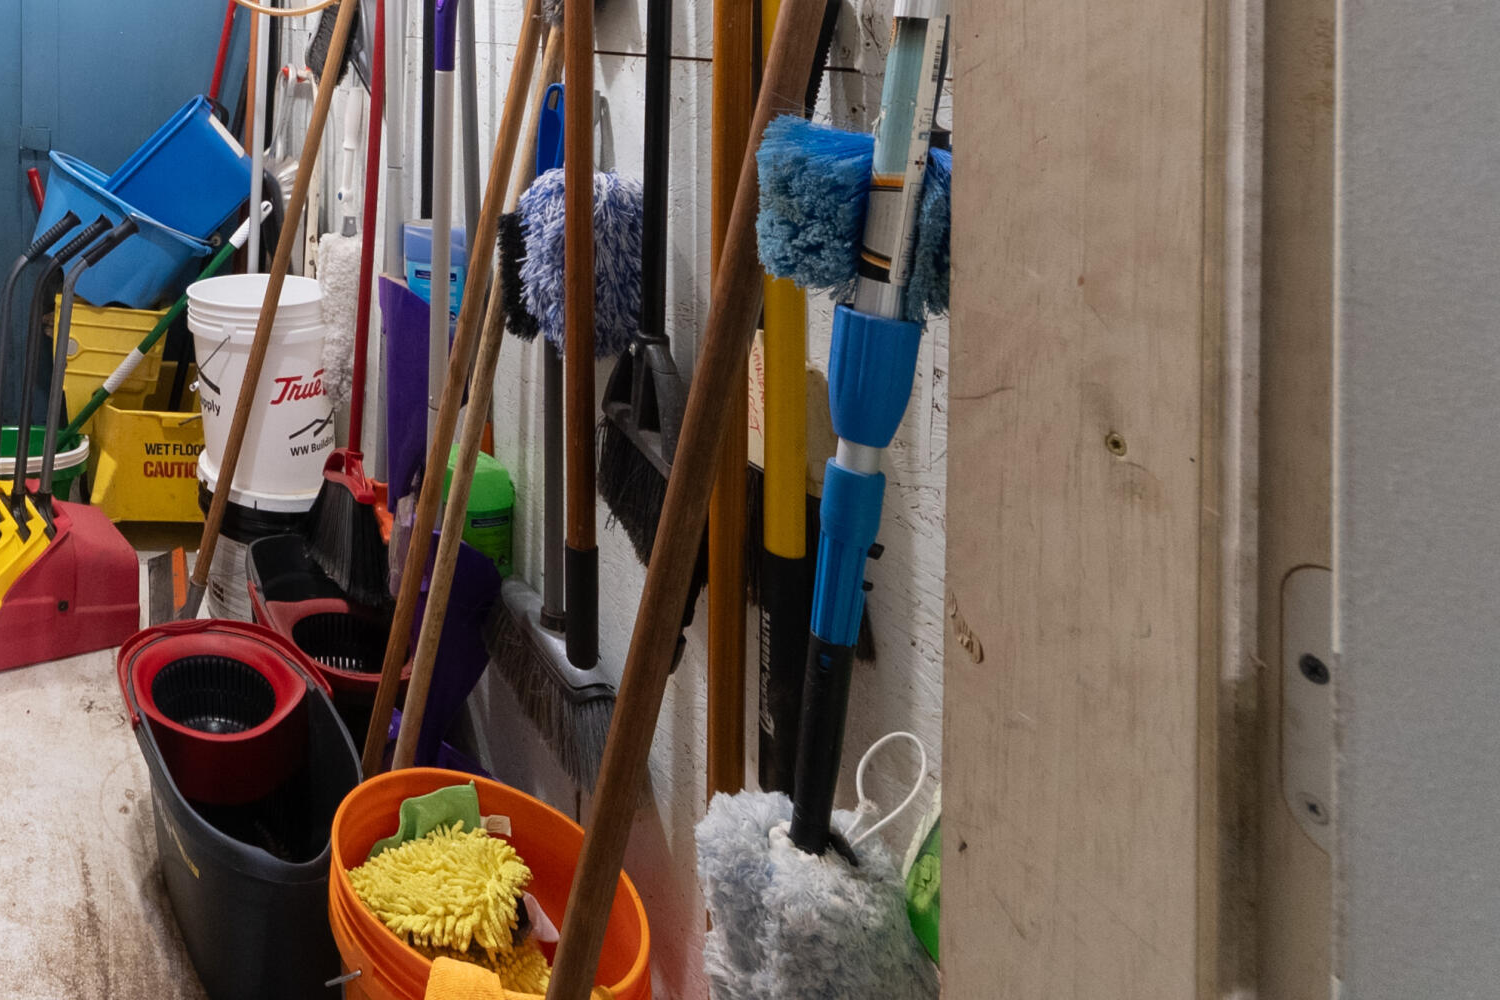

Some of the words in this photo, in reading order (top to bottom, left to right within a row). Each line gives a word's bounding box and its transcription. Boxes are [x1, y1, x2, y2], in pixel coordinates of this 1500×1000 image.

[144, 443, 173, 456] WET
[172, 443, 205, 456] FLOO
[289, 445, 310, 458] WW
[310, 436, 335, 453] Buildin
[143, 460, 199, 478] CAUTIO
